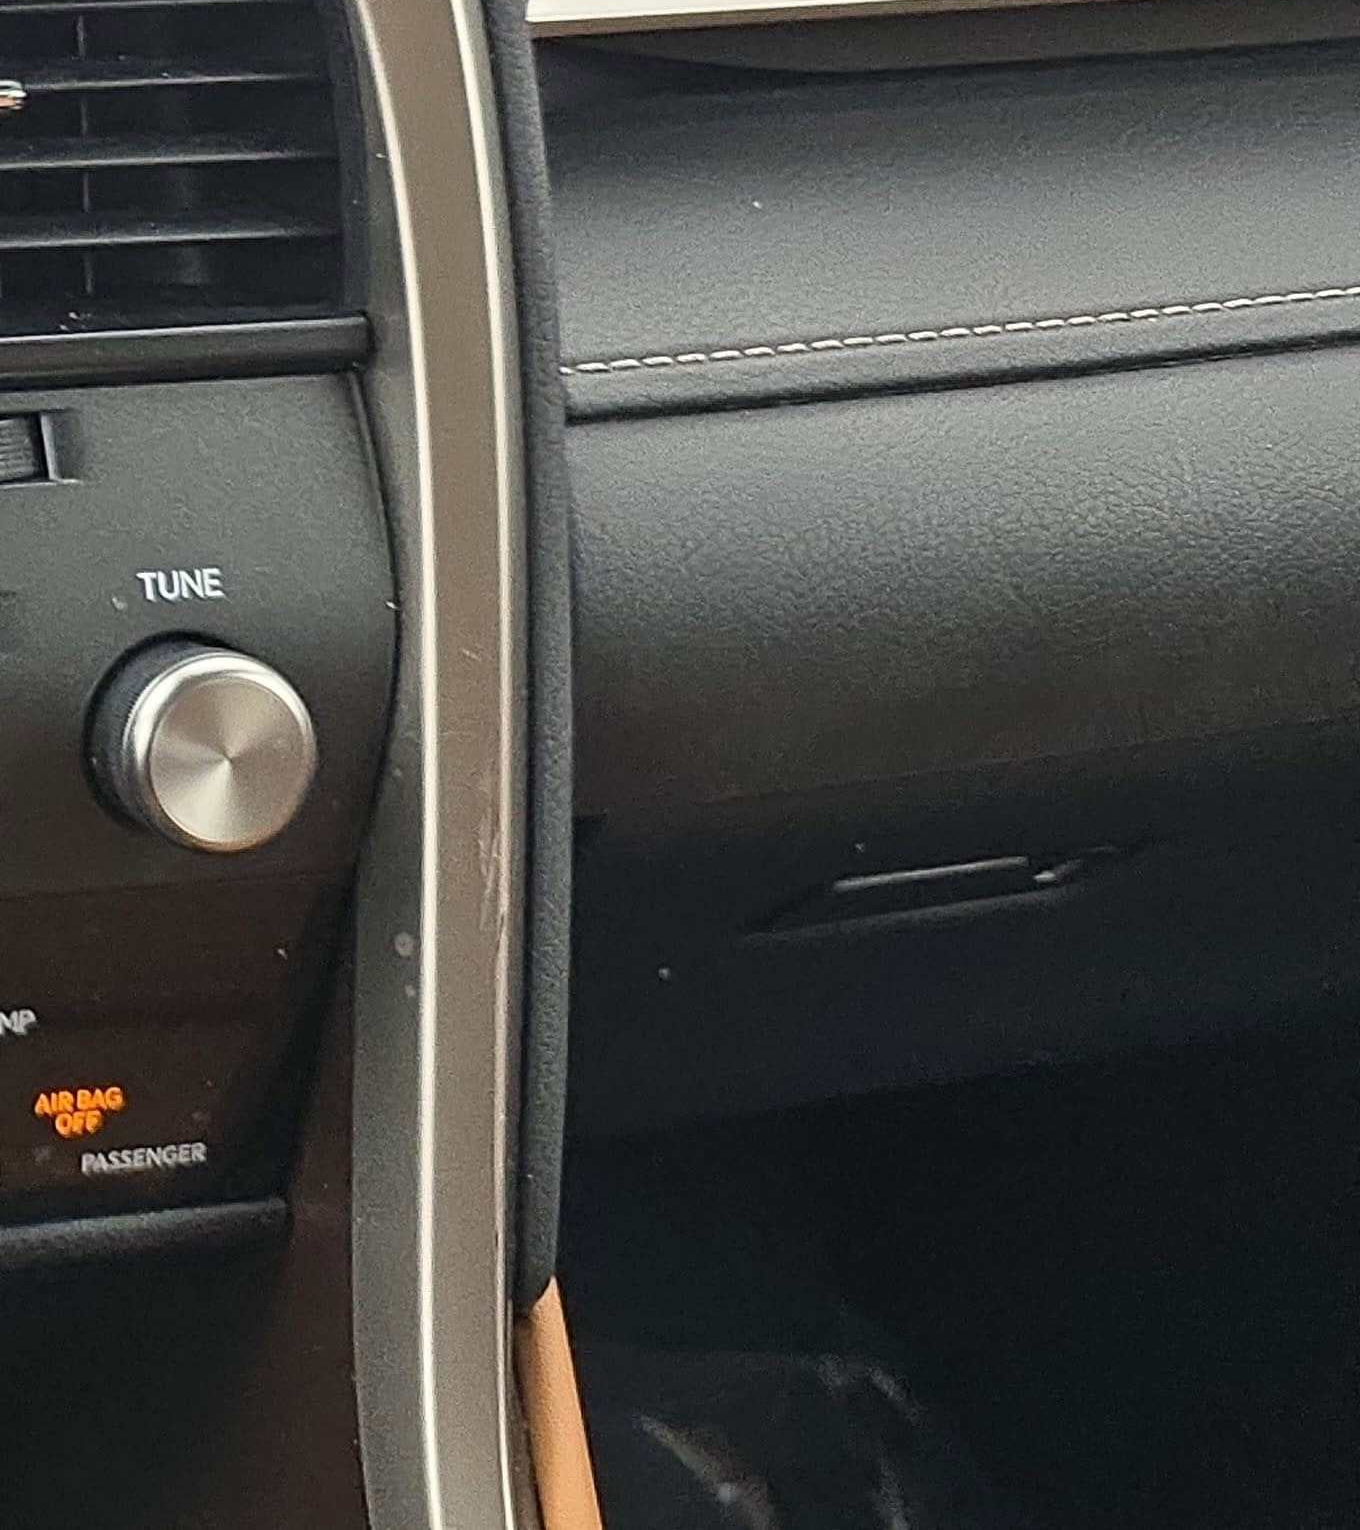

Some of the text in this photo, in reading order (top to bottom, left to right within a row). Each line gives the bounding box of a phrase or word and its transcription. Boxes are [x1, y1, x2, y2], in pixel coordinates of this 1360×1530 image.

[136, 567, 224, 602] TUNE
[34, 1086, 124, 1118] AIR BAG
[55, 1110, 104, 1139] OFF
[81, 1142, 208, 1176] PASSENGER
